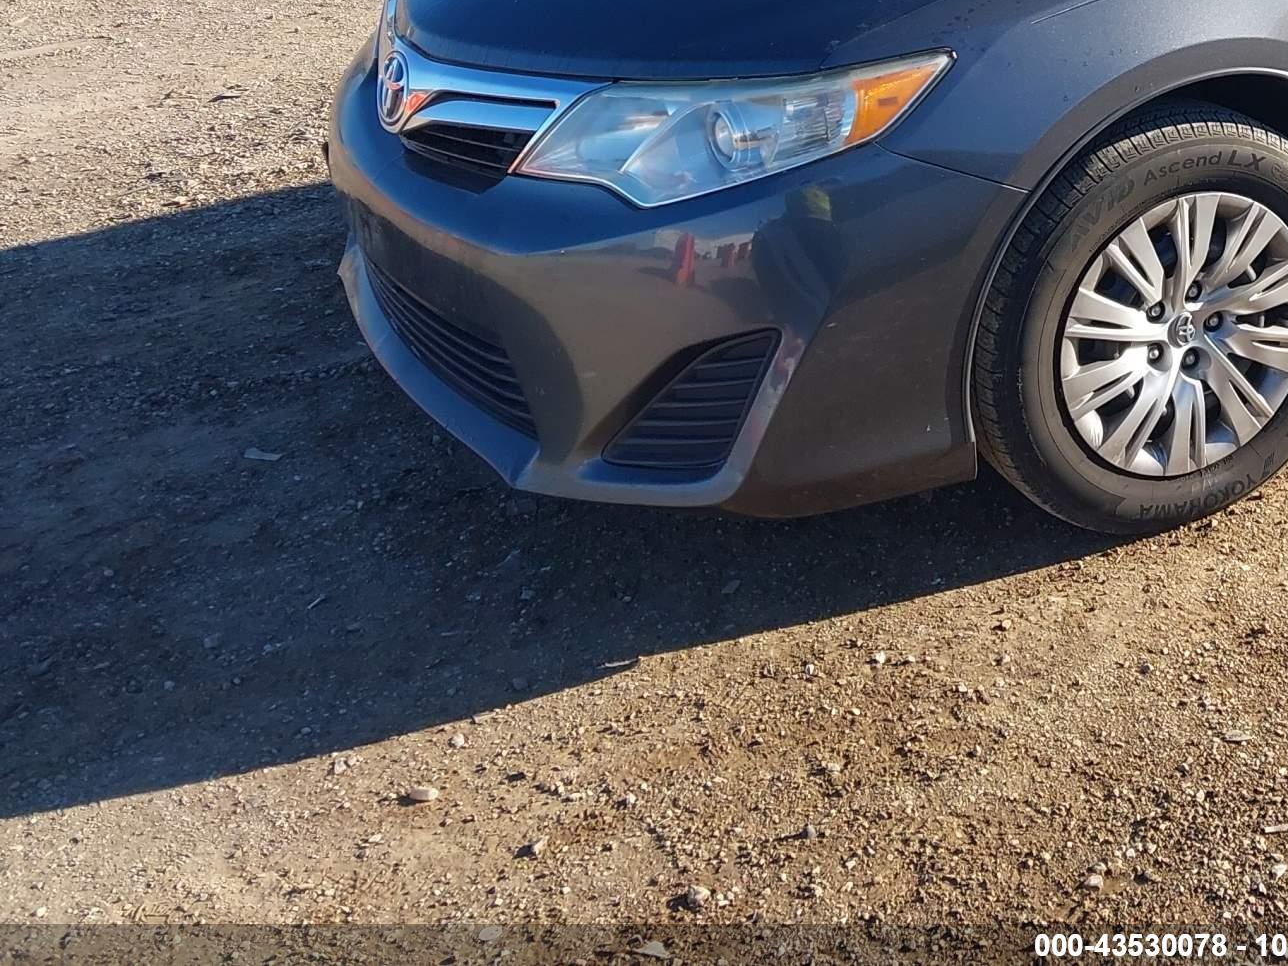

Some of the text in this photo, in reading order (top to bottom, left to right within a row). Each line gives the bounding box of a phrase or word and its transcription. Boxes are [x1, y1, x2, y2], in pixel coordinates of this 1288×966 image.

[1143, 150, 1222, 184] Ascend
[1226, 149, 1268, 172] LX
[1139, 473, 1257, 519] YOKOHAMA
